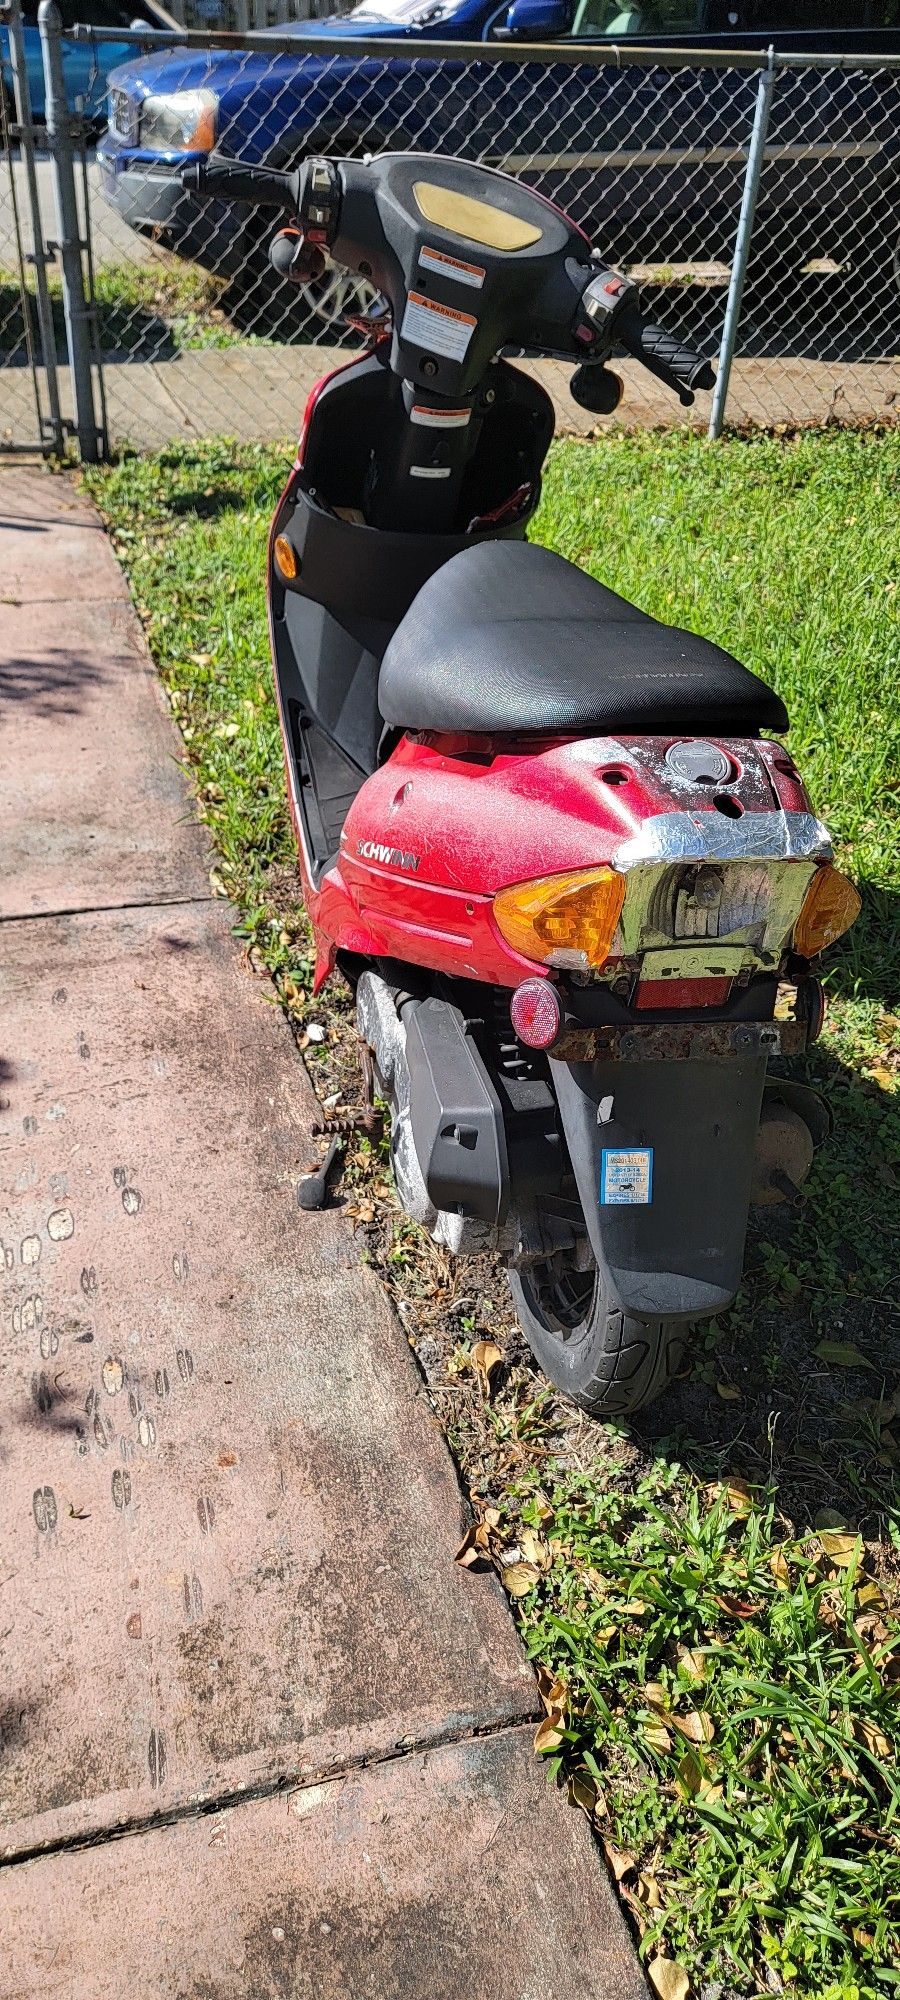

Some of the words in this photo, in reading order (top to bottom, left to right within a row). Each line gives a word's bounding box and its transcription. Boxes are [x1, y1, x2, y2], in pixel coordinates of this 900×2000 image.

[444, 257, 469, 271] WARNING
[430, 303, 463, 320] WARNING
[356, 838, 421, 872] SCHWINN
